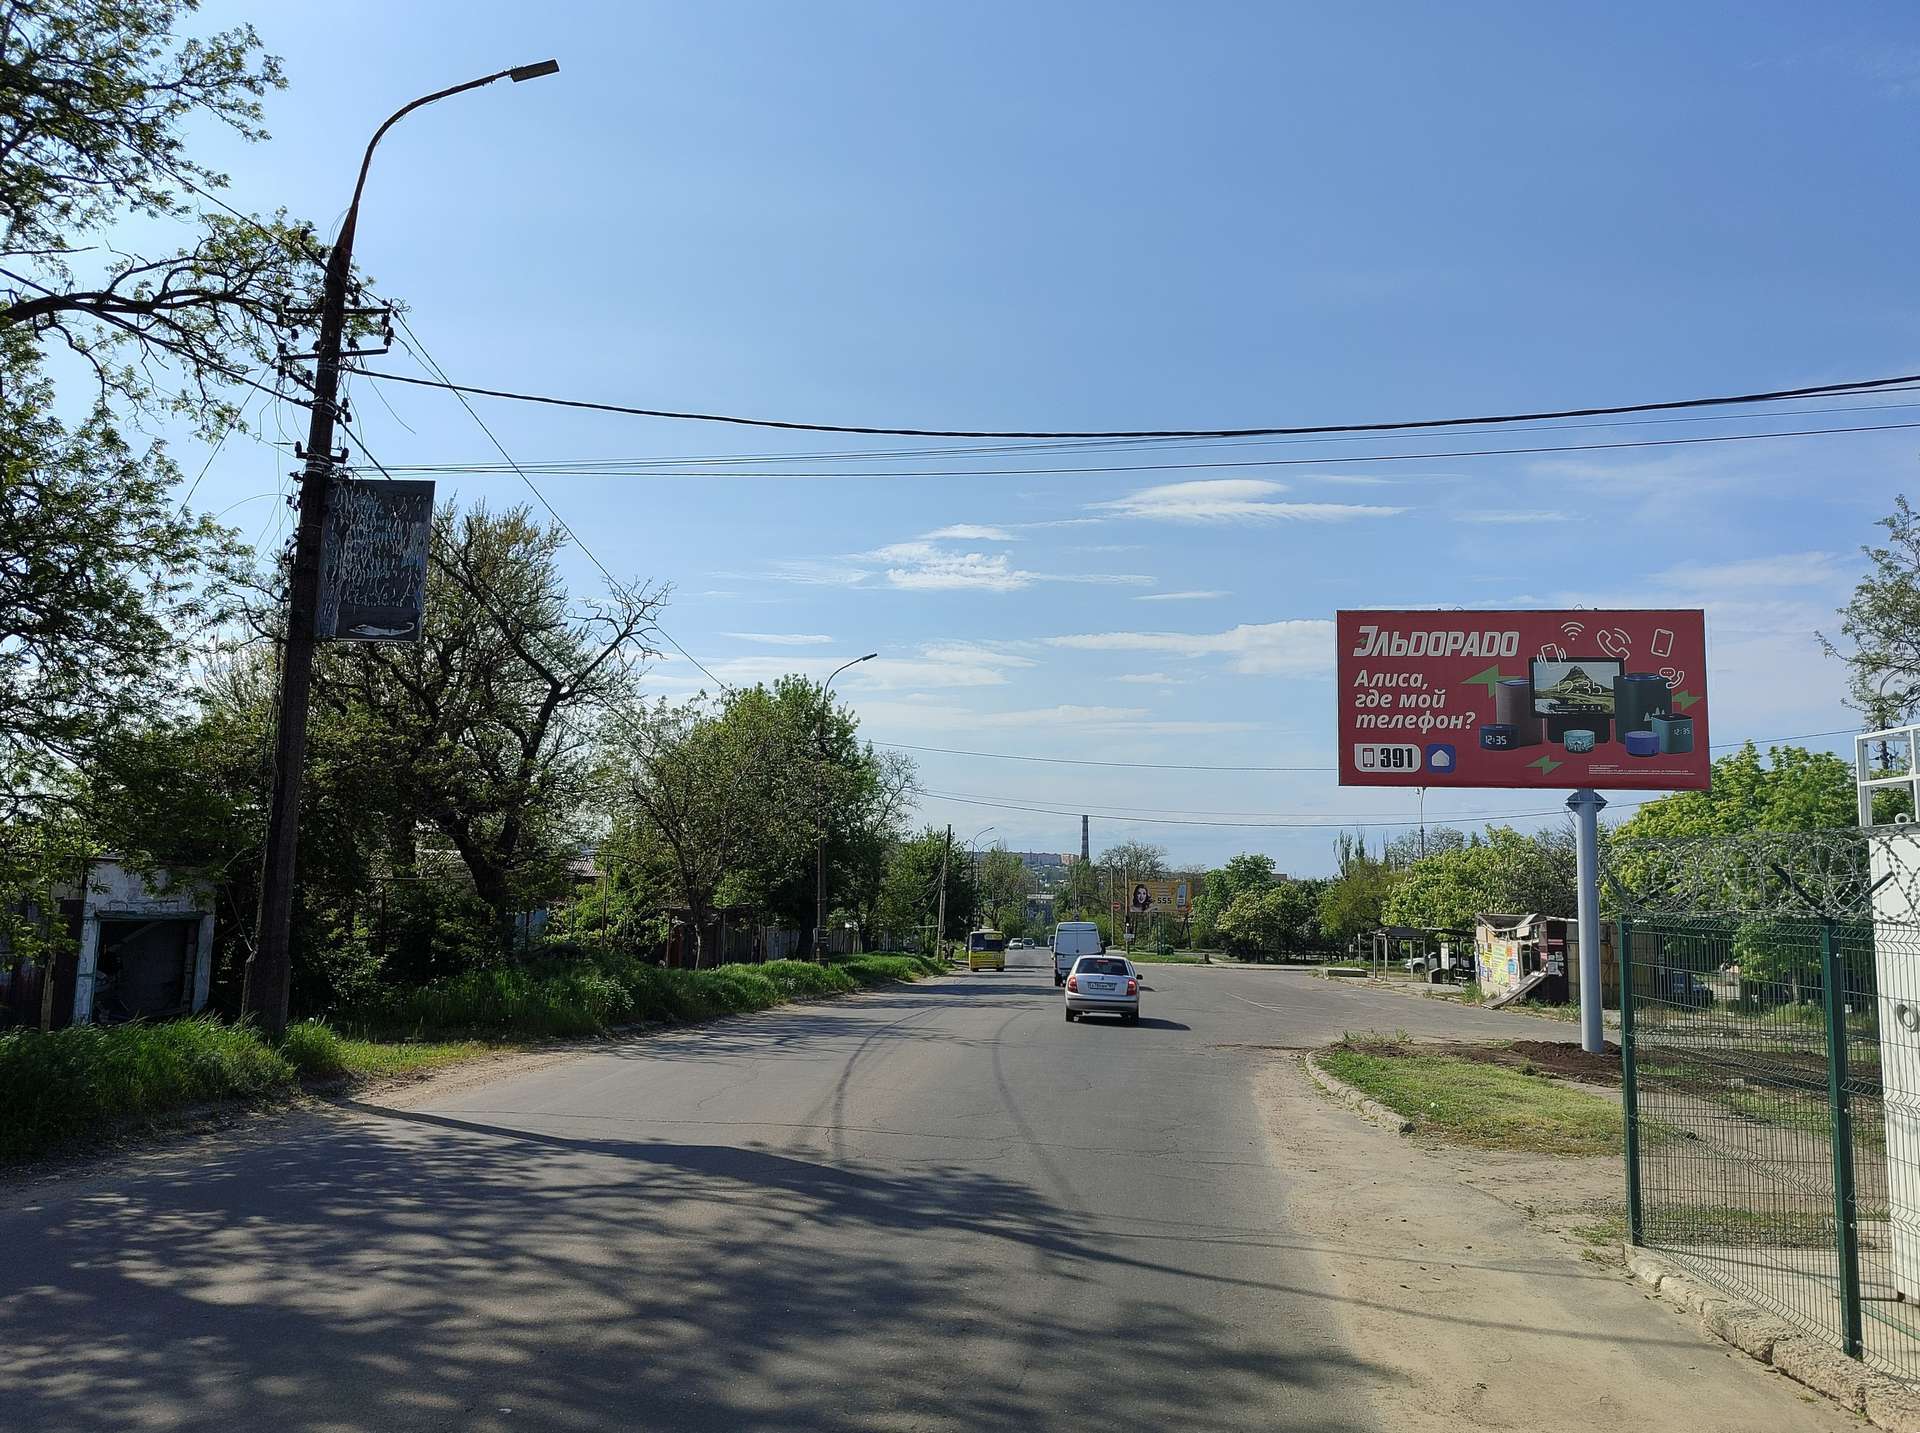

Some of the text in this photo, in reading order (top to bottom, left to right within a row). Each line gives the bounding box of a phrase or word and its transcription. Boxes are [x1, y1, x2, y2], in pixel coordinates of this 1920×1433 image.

[1354, 669, 1428, 690] Алиса,
[1355, 689, 1446, 708] где мой
[1356, 710, 1476, 734] телефон?
[1485, 735, 1507, 745] 12:35
[1380, 747, 1413, 768] 391
